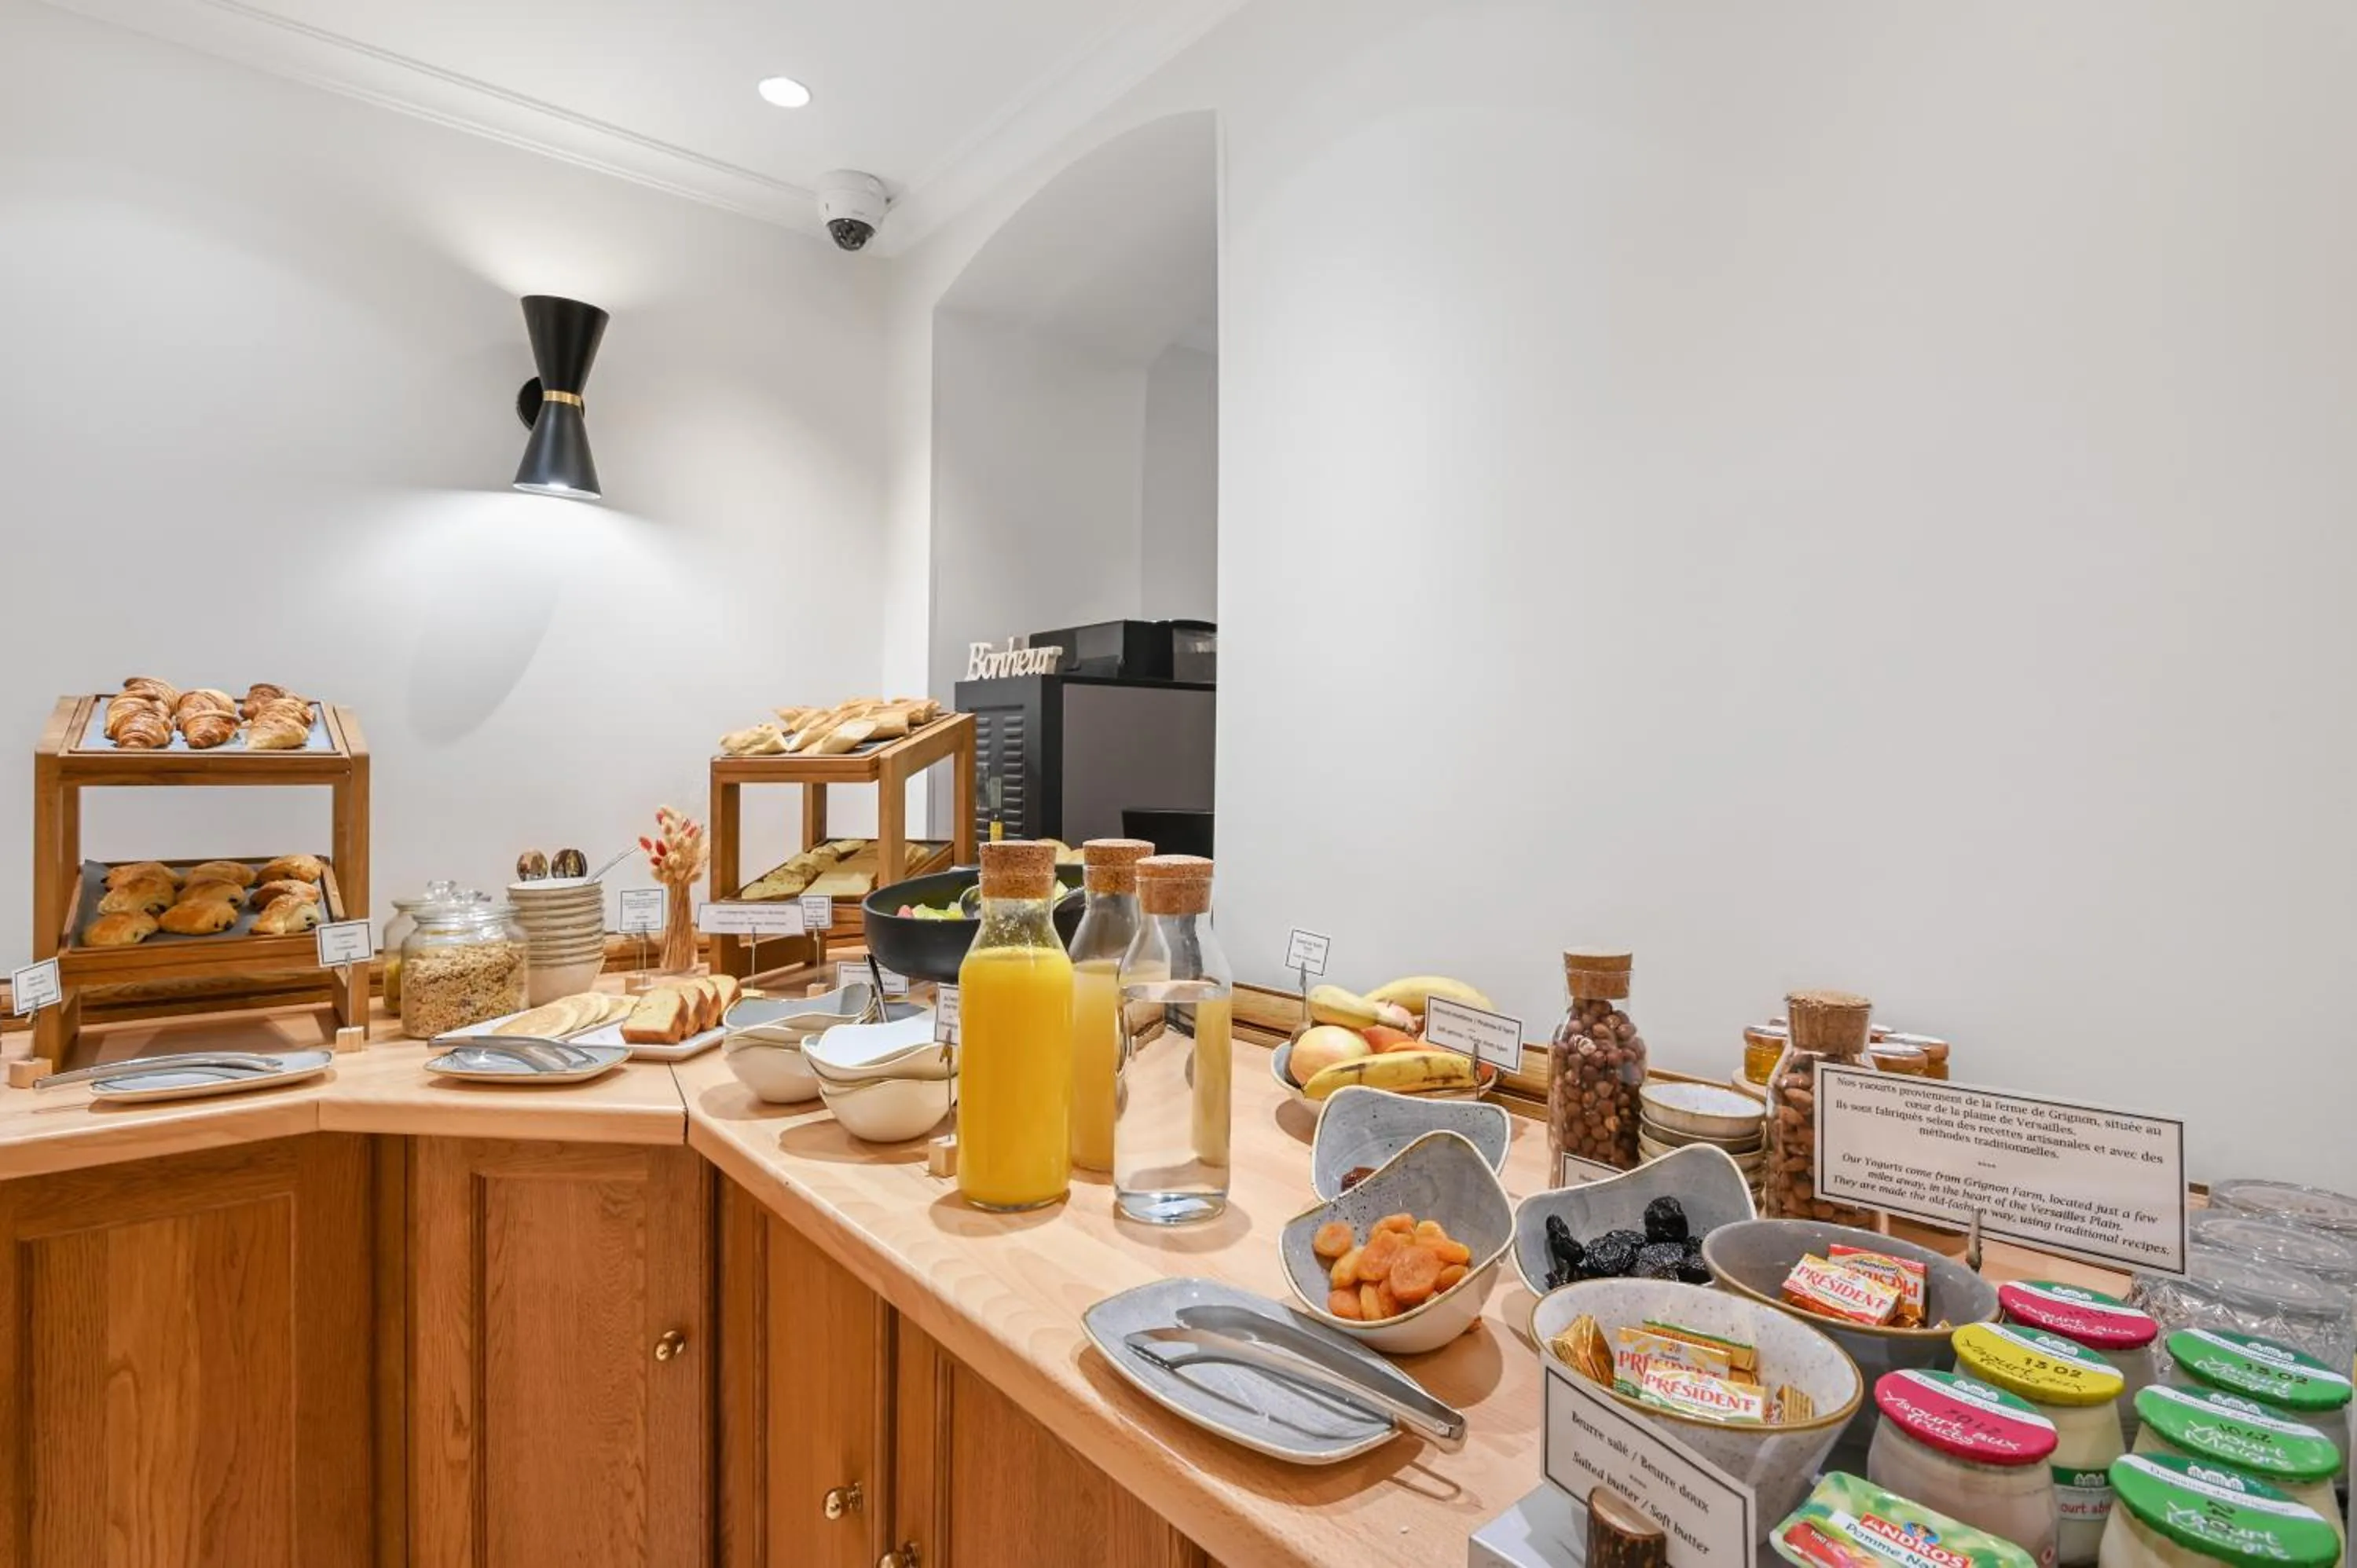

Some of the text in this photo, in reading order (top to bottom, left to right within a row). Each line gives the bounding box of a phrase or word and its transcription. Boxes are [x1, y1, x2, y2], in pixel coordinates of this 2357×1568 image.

[965, 636, 1063, 680] Bonheur
[1835, 1100, 2164, 1164] Ils sont fabriqués selon des recettes artisanales et avec des
[1837, 1077, 1856, 1087] Nos
[1899, 1086, 1963, 1104] proviennent
[1965, 1094, 1979, 1106] de
[1982, 1097, 1992, 1108] la
[2031, 1105, 2045, 1117] de
[2048, 1110, 2100, 1127] Grignon,
[2105, 1119, 2143, 1133] située
[2146, 1126, 2161, 1136] au
[1934, 1104, 1948, 1114] de
[1950, 1105, 1961, 1116] la
[1963, 1108, 1996, 1123] plaine
[2000, 1116, 2014, 1126] de
[2016, 1118, 2077, 1136] Versailles.
[1919, 1127, 2059, 1159] méthodes traditionnelles.
[1834, 1174, 2171, 1255] They are made the old-fashin way, using traditional recipes.
[1842, 1152, 1861, 1163] Our
[1864, 1156, 1903, 1173] Yogurts
[1905, 1167, 1932, 1178] come
[1935, 1171, 1960, 1185] from
[1964, 1178, 2010, 1195] Grignon
[2012, 1185, 2045, 1203] Farm,
[2049, 1193, 2092, 1211] located
[2095, 1203, 2119, 1217] just
[2133, 1211, 2159, 1224] few
[1868, 1171, 2123, 1231] miles away, in the heart of the Versailles Plain.
[1883, 1389, 1963, 1430] Yaourt
[1972, 1432, 2022, 1451] aux
[1571, 1410, 1605, 1442] Beurre
[1607, 1437, 1629, 1456] salé
[1640, 1455, 1676, 1489] Beurre
[1679, 1484, 1710, 1515] doux
[1572, 1451, 1604, 1481] Salted
[1607, 1472, 1640, 1503] butter
[1650, 1504, 1671, 1530] Soft
[1673, 1522, 1710, 1555] butter
[1846, 1522, 1902, 1555] Pomme
[1863, 1519, 1964, 1568] ANDROS
